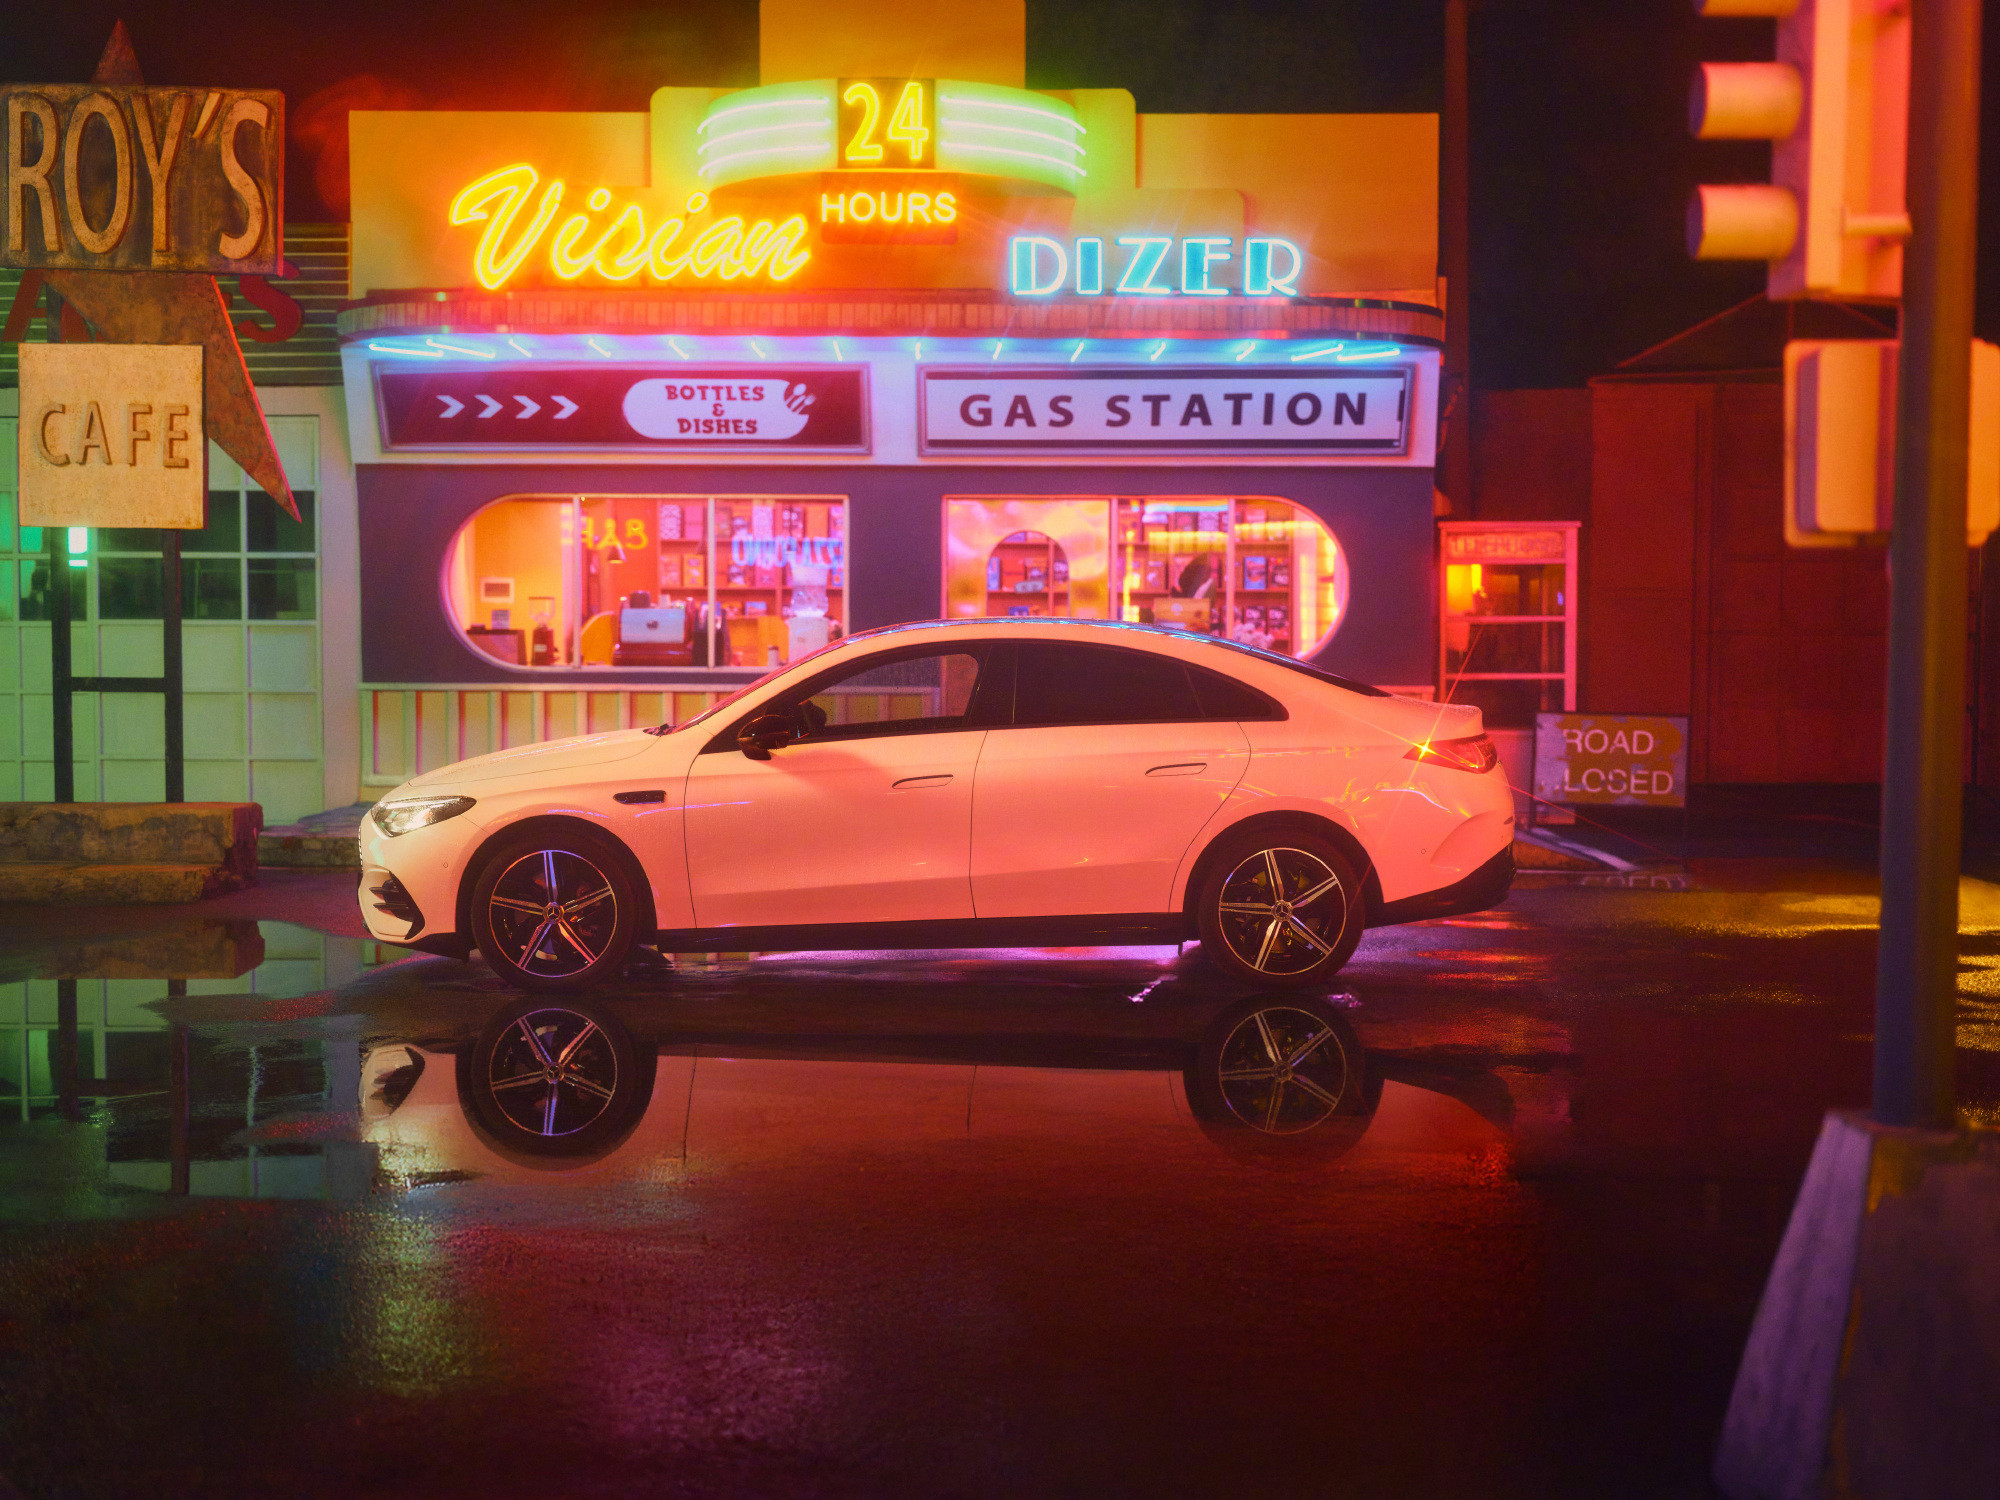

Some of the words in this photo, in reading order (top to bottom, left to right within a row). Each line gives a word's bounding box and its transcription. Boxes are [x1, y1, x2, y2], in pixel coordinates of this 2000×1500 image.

[844, 82, 930, 161] 24
[7, 91, 271, 260] ROY'S
[820, 191, 958, 225] HOURS
[1010, 236, 1302, 297] DIZER
[665, 385, 764, 401] BOTTLES
[712, 403, 725, 416] &
[960, 393, 1076, 429] GAS
[1105, 391, 1368, 428] STATION
[36, 402, 189, 468] CAFE
[678, 418, 758, 434] DISHES
[1563, 729, 1654, 755] ROAD
[1539, 767, 1673, 794] LOSED
